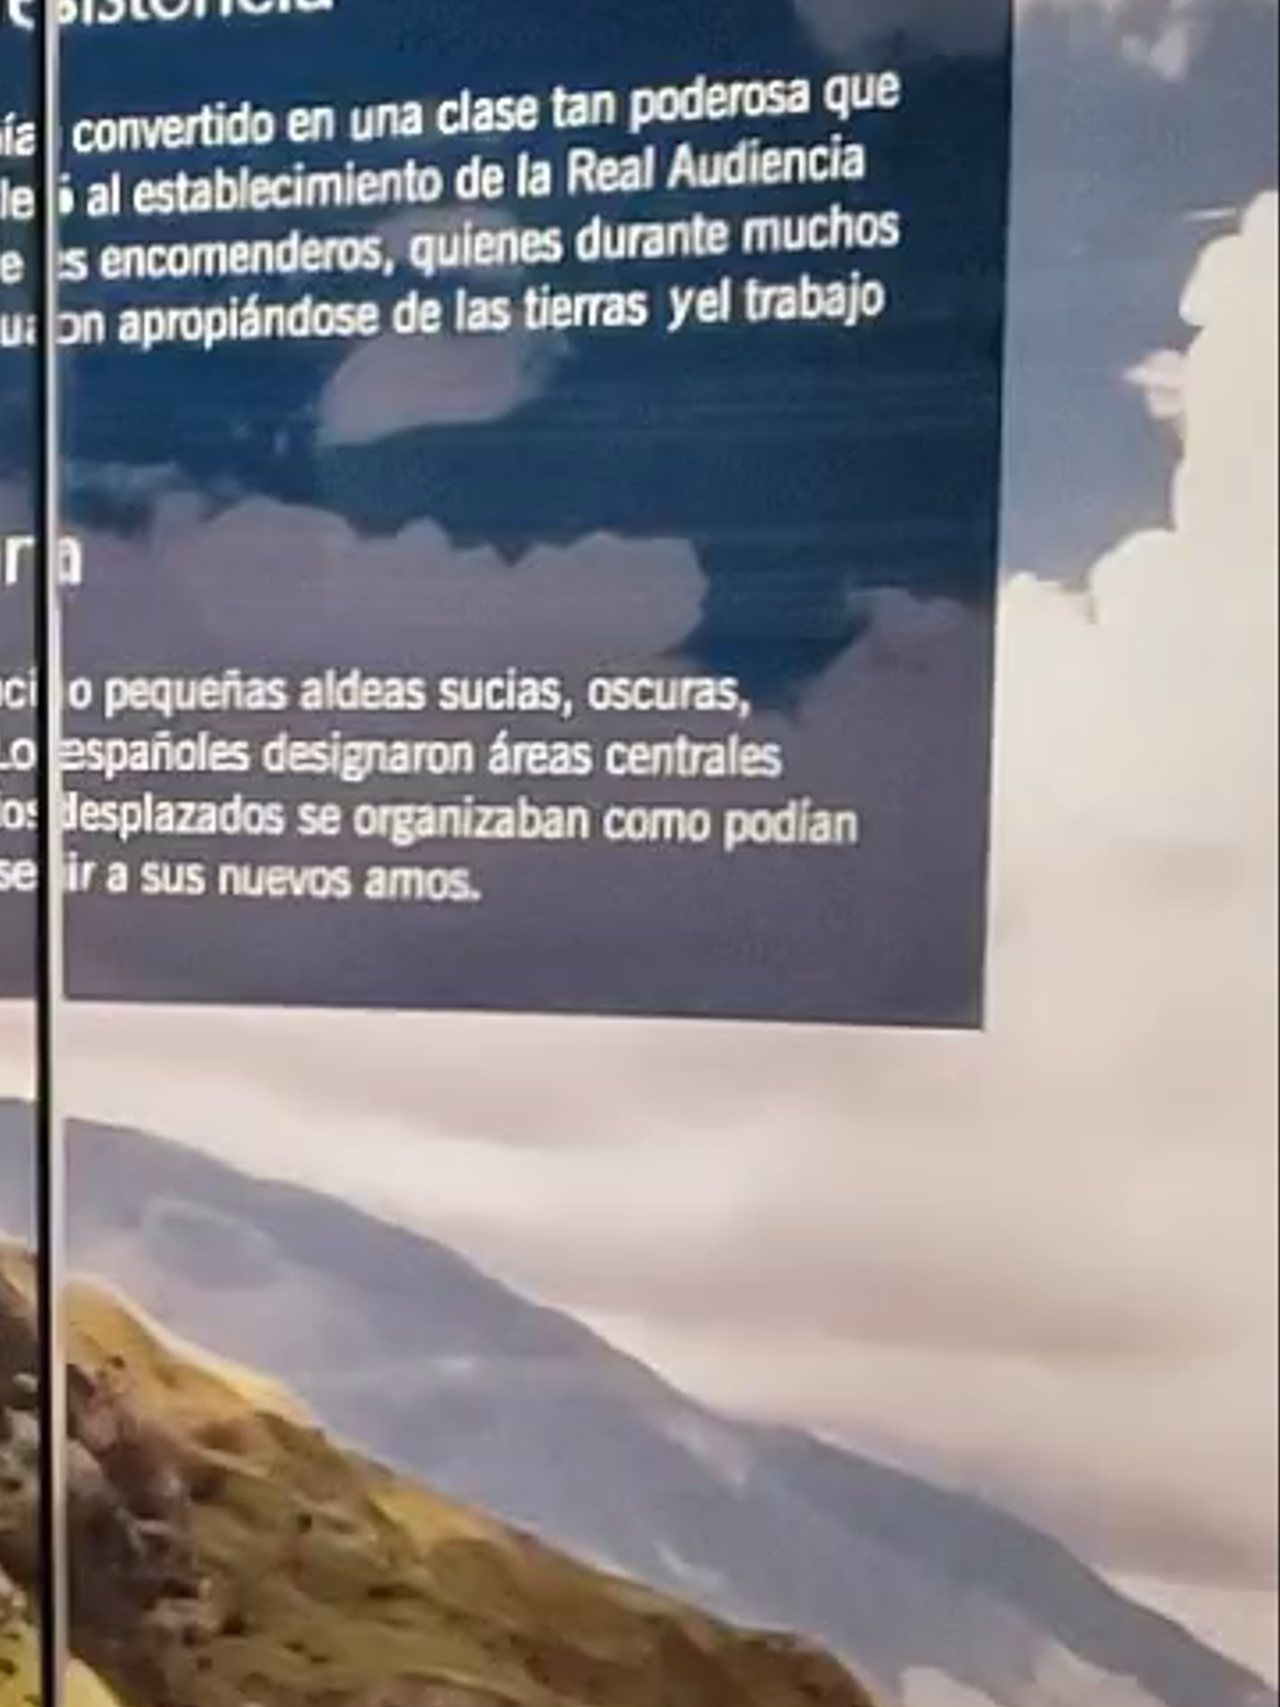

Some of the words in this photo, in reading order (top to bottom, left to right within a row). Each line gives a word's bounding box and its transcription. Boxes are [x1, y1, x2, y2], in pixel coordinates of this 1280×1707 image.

[71, 100, 277, 155] convertido
[286, 106, 336, 144] en
[349, 100, 424, 143] una
[435, 87, 540, 136] clase
[550, 84, 617, 129] tan
[628, 73, 811, 135] poderosa
[822, 70, 901, 122] que
[86, 170, 121, 219] al
[132, 158, 444, 216] establecimiento
[454, 154, 505, 201] de
[516, 150, 552, 198] la
[566, 144, 656, 196] Real
[665, 132, 867, 190] Audiencia
[99, 228, 395, 280] encomenderos,
[409, 220, 565, 278] quienes
[574, 211, 731, 263] durante
[741, 202, 901, 255] muchos
[117, 292, 380, 352] apropiándose
[392, 289, 442, 334] de
[455, 287, 512, 332] las
[522, 282, 650, 331] tierras
[743, 269, 886, 327] trabajo
[104, 668, 289, 719] pequeñas
[298, 668, 427, 711] aldeas
[438, 667, 573, 719] sucias,
[587, 676, 751, 720] oscuras,
[262, 730, 474, 783] designaron
[487, 729, 594, 776] áreas
[605, 733, 783, 778] centrales
[297, 802, 342, 836] se
[353, 794, 590, 847] organizaban
[602, 805, 712, 843] como
[724, 797, 858, 852] podían
[105, 861, 129, 893] a
[140, 860, 206, 896] sus
[218, 863, 353, 899] nuevos
[364, 865, 482, 902] amos.
